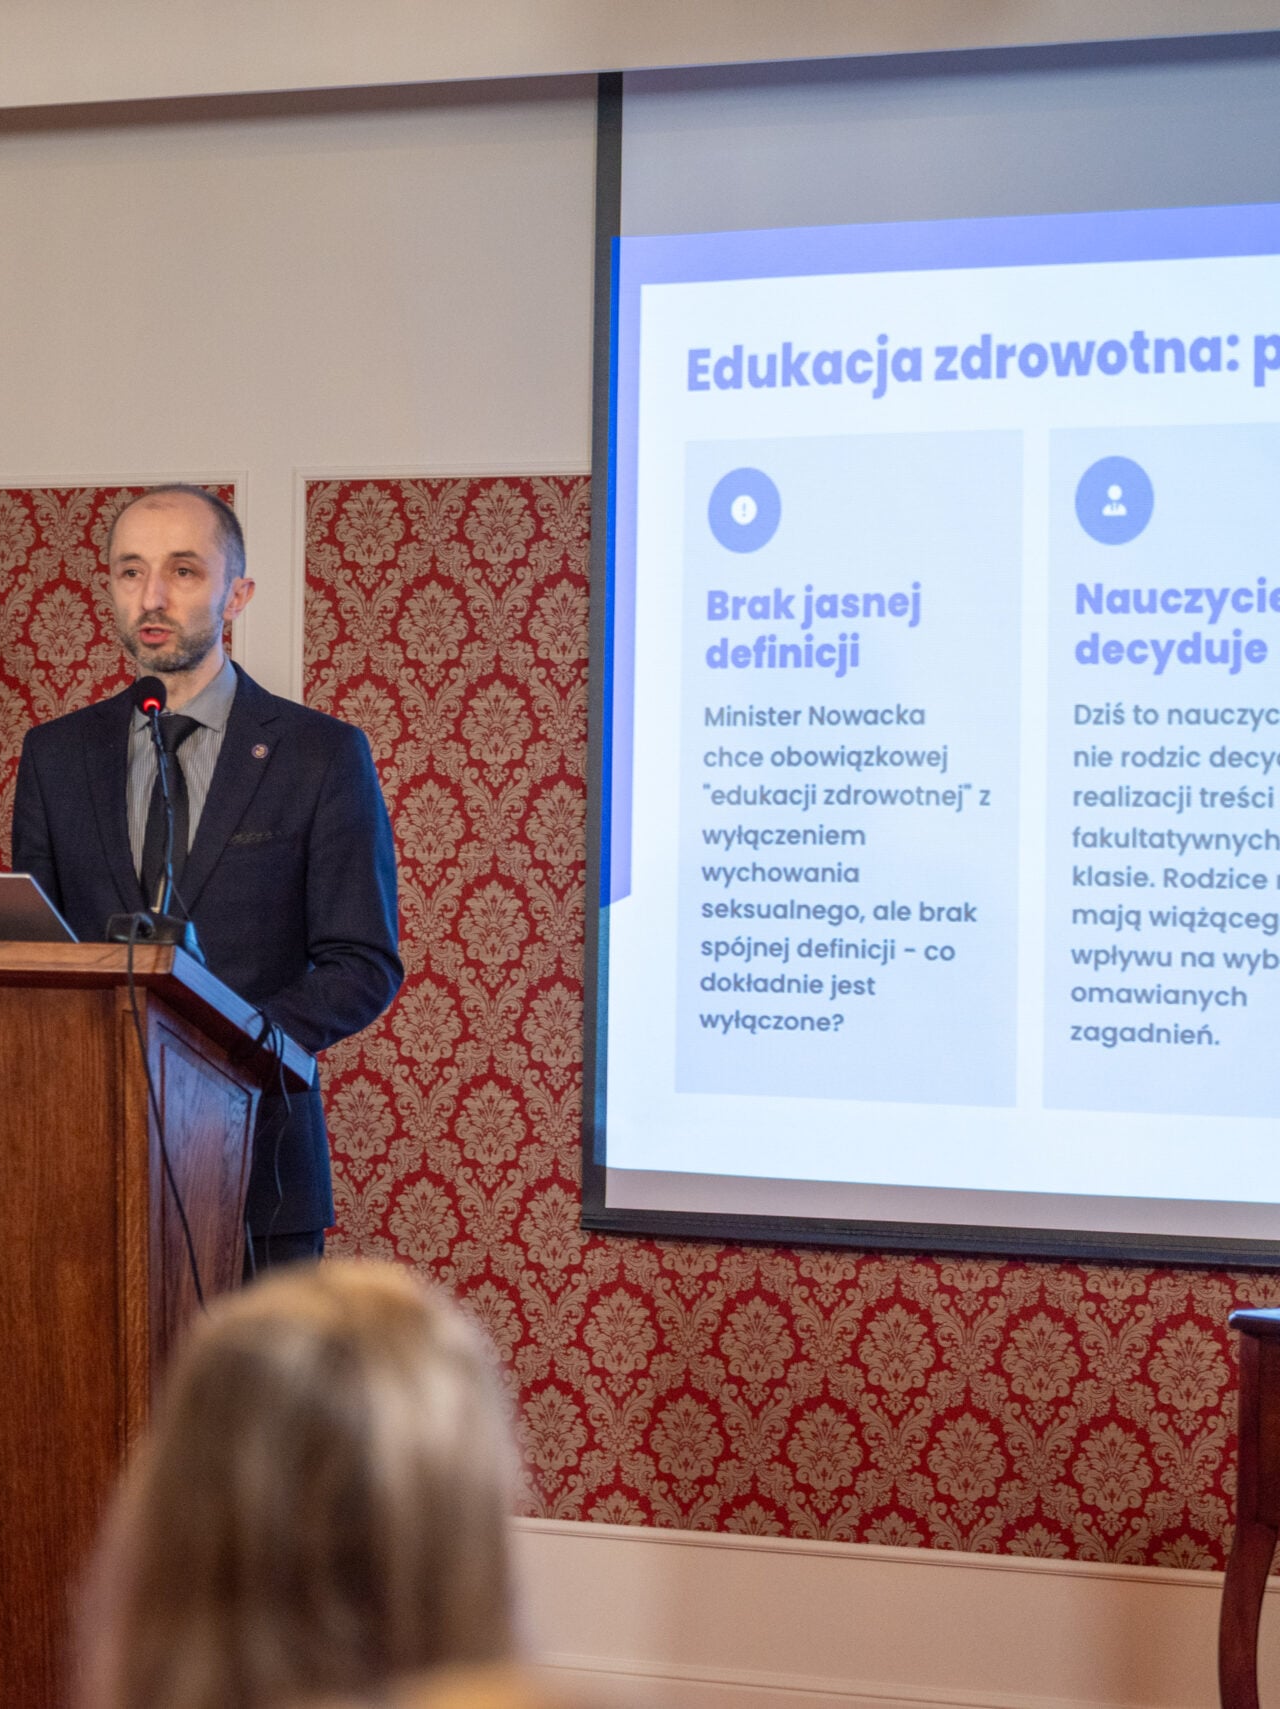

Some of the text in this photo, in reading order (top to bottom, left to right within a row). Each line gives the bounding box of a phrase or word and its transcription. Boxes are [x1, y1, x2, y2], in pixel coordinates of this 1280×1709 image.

[687, 333, 922, 400] Edukacja
[934, 330, 1240, 381] zdrowotna:
[706, 582, 922, 630] Brak jasnej
[705, 633, 860, 678] definicji
[1075, 628, 1268, 676] decyduje
[704, 704, 926, 727] Minister Nowacka
[1074, 702, 1125, 726] Dziś
[1133, 705, 1160, 726] to
[703, 745, 948, 774] chce obowiązkowej
[1073, 746, 1113, 768] nie
[1120, 745, 1201, 768] rodzic
[702, 783, 991, 813] "edukacji zdrowotnej" z
[1073, 786, 1274, 815] realizacji treści
[702, 824, 866, 851] wyłączeniem
[1072, 826, 1280, 857] fakultatywnych
[701, 862, 860, 888] wychowania
[1072, 866, 1268, 890] klasie. Rodzice
[701, 899, 978, 926] seksualnego, ale brak
[1071, 904, 1280, 936] mają wiążąceg
[700, 936, 790, 964] spójnej
[797, 938, 896, 966] definicji
[923, 944, 956, 961] co
[1071, 945, 1172, 972] wpływu
[1180, 950, 1215, 968] na
[699, 972, 876, 1001] dokładnie jest
[1071, 984, 1248, 1012] omawianych
[699, 1010, 844, 1035] wyłączone?
[1071, 1023, 1220, 1049] zagadnień.
